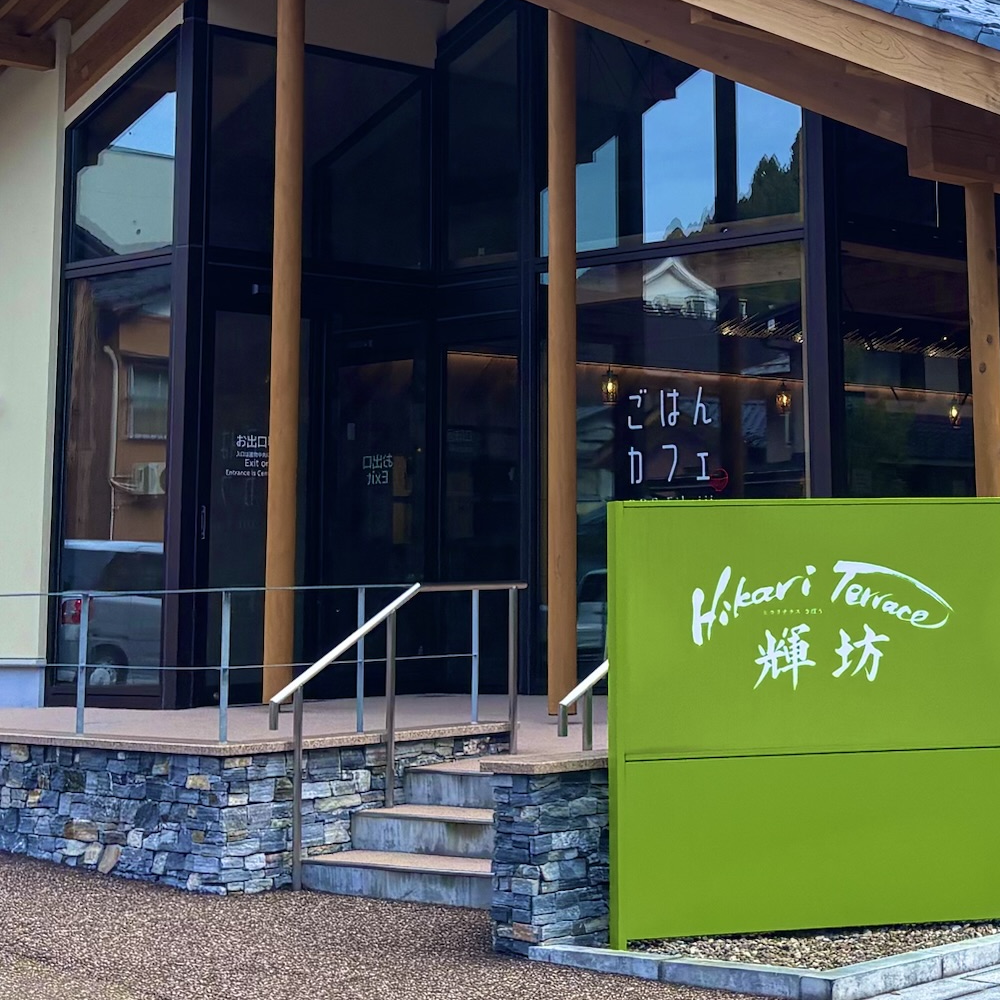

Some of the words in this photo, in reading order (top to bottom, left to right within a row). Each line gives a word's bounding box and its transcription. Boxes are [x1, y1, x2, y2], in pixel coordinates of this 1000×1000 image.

[628, 386, 712, 430] ごはん
[236, 434, 270, 449] お出口
[225, 469, 250, 477] Entrance
[244, 458, 259, 468] Exit
[628, 444, 710, 484] カフェ
[691, 564, 817, 647] Hikari
[830, 559, 955, 630] Terrace
